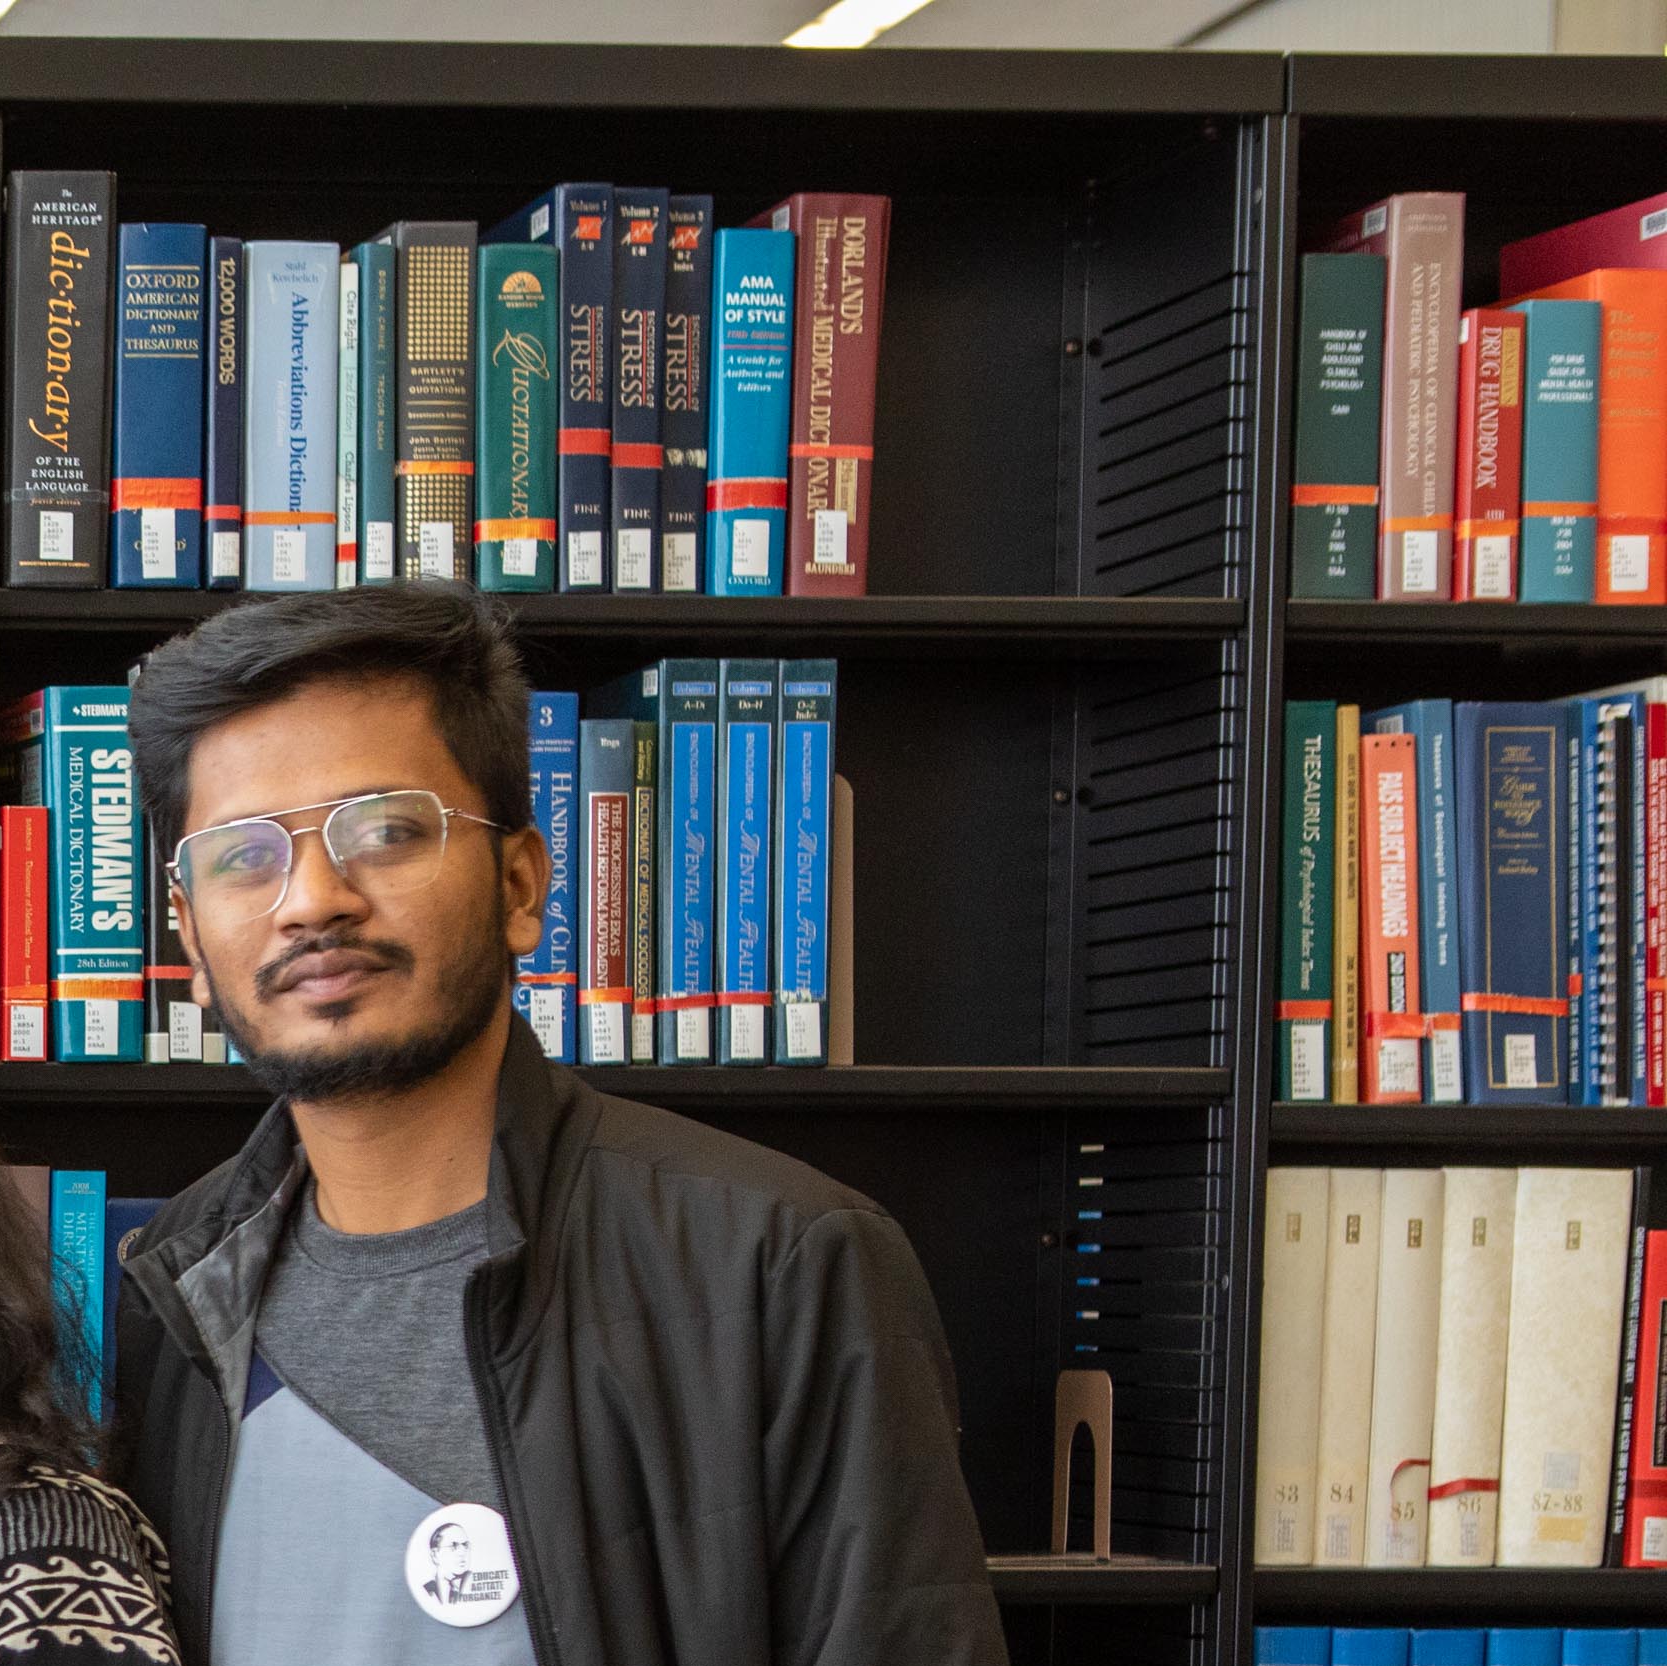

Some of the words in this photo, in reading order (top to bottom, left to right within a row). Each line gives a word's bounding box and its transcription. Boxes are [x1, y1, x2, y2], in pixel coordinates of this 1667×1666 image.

[33, 202, 97, 213] AMERICAN
[126, 274, 199, 288] OXFORD
[217, 258, 235, 314] 12,000
[739, 276, 774, 289] AMA
[126, 292, 199, 305] AMERICAN
[726, 292, 786, 306] MANUAL
[126, 308, 199, 320] DICTIONARY
[725, 310, 743, 324] OF
[747, 310, 785, 324] STYLE
[149, 324, 175, 334] AND
[125, 338, 199, 350] THESAURUS
[219, 318, 235, 385] WORDS
[570, 304, 591, 402] STRESS
[621, 308, 643, 408] STRESS
[811, 311, 833, 398] MEDICAL
[1479, 326, 1502, 378] DRUG
[290, 292, 309, 432] Abbreviations
[666, 314, 687, 412] STRESS
[1475, 380, 1500, 490] HANDBOOK
[35, 456, 52, 466] OF
[56, 456, 81, 466] THE
[31, 468, 84, 480] ENGLISH
[25, 482, 89, 494] LANGUAGE
[574, 503, 601, 514] FINK
[623, 508, 651, 520] FINK
[668, 511, 695, 523] FINK
[81, 704, 127, 716] STEDMAN'S
[539, 706, 553, 726] 3
[69, 746, 84, 824] MEDICAL
[1303, 734, 1322, 842] THESAURUS
[91, 748, 133, 930] STEDMAN'S
[550, 772, 572, 894] HANDBOOK
[69, 828, 85, 933] DICTIONARY
[99, 959, 129, 968] Edition
[1330, 1485, 1353, 1502] 84
[1392, 1502, 1415, 1521] 85
[1457, 1496, 1481, 1514] 86
[473, 1570, 509, 1581] EDUCATE
[471, 1581, 504, 1592] AGITATE
